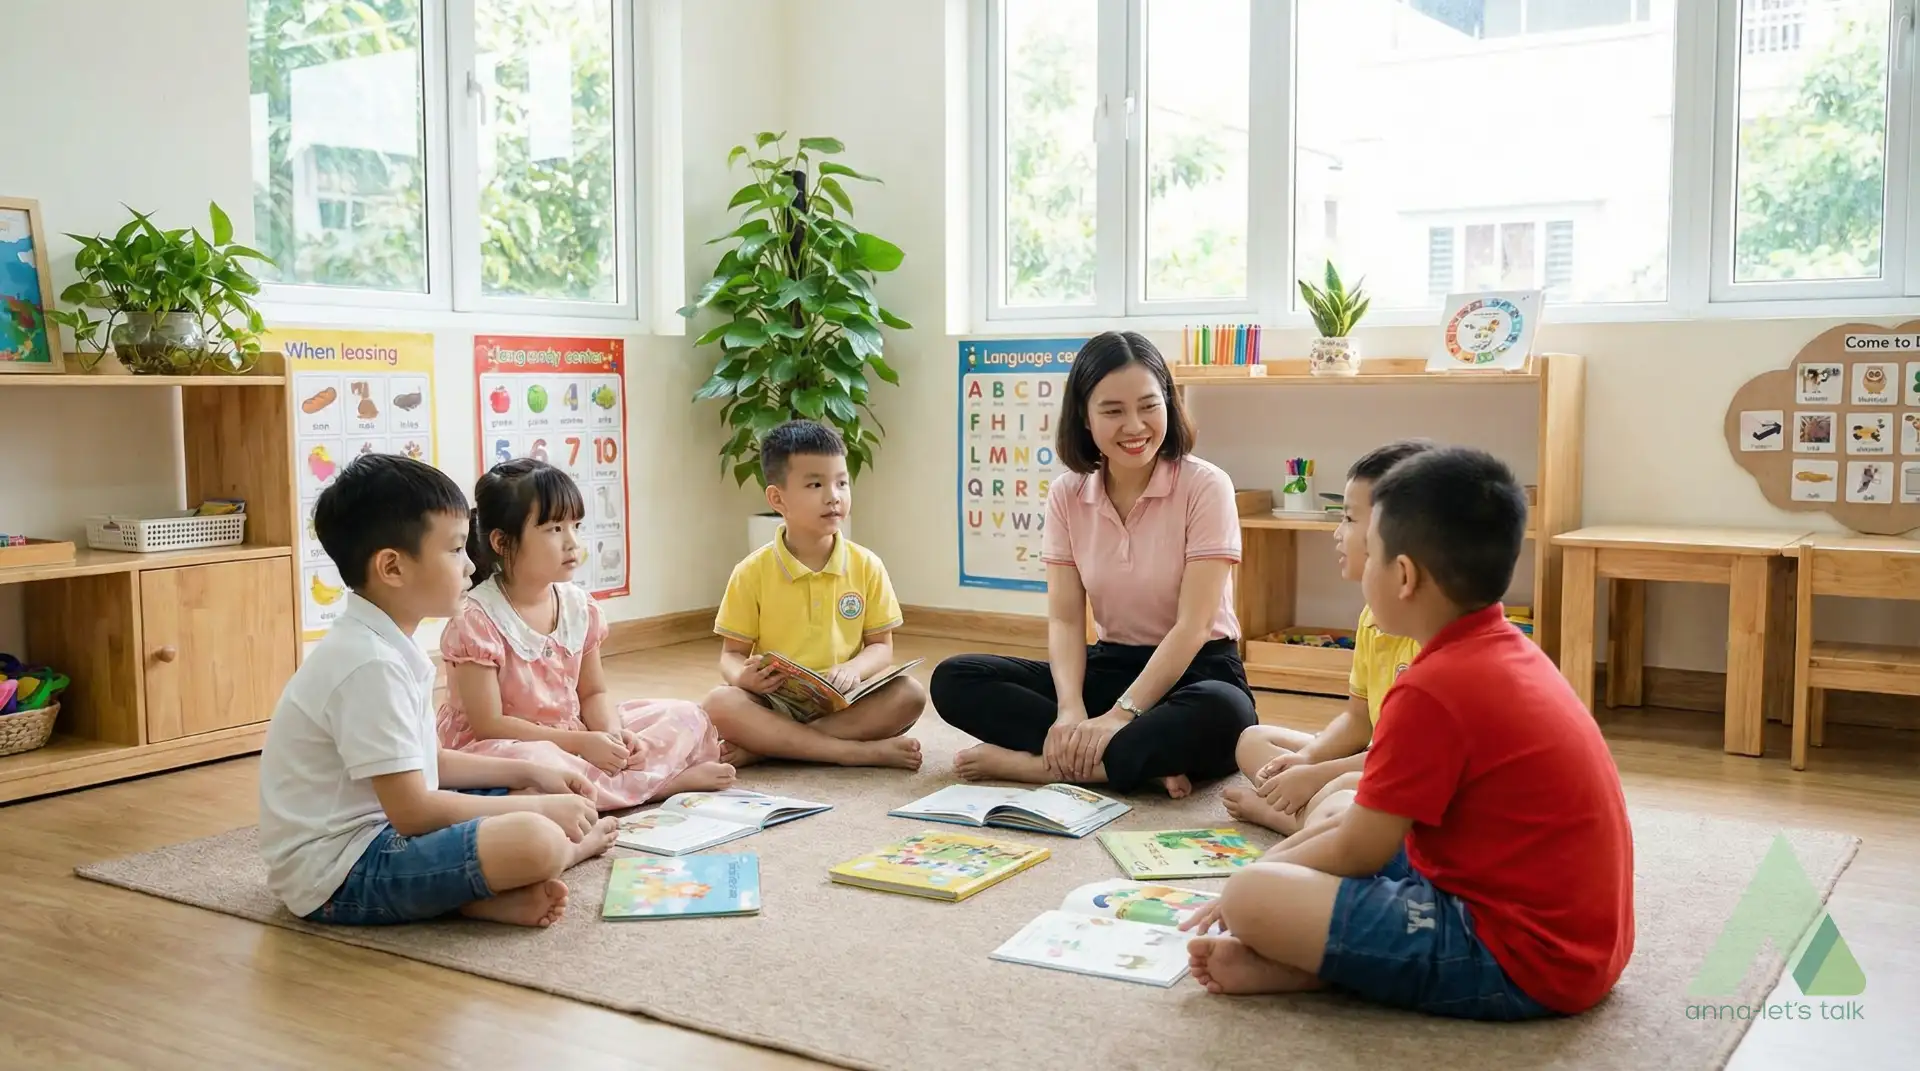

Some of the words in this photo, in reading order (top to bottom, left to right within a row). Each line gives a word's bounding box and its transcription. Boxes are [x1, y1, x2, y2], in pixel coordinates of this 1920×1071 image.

[1846, 336, 1889, 348] Come
[1894, 336, 1911, 348] to
[285, 342, 335, 360] When
[341, 343, 398, 365] leasing
[984, 349, 1053, 367] Language
[968, 380, 983, 398] A
[992, 381, 1005, 398] B
[1014, 380, 1028, 398] C
[1038, 381, 1052, 398] D
[970, 413, 980, 431] F
[991, 413, 1005, 431] H
[1039, 414, 1049, 431] J
[564, 437, 581, 466] 7
[593, 437, 618, 464] 10
[970, 446, 980, 463] L
[989, 446, 1008, 464] M
[1014, 446, 1030, 465] N
[1036, 446, 1053, 465] O
[967, 478, 983, 497] Q
[992, 479, 1004, 497] R
[1015, 480, 1028, 497] R
[1039, 480, 1049, 498] S
[968, 510, 983, 528] U
[991, 511, 1005, 529] V
[1011, 512, 1032, 530] W
